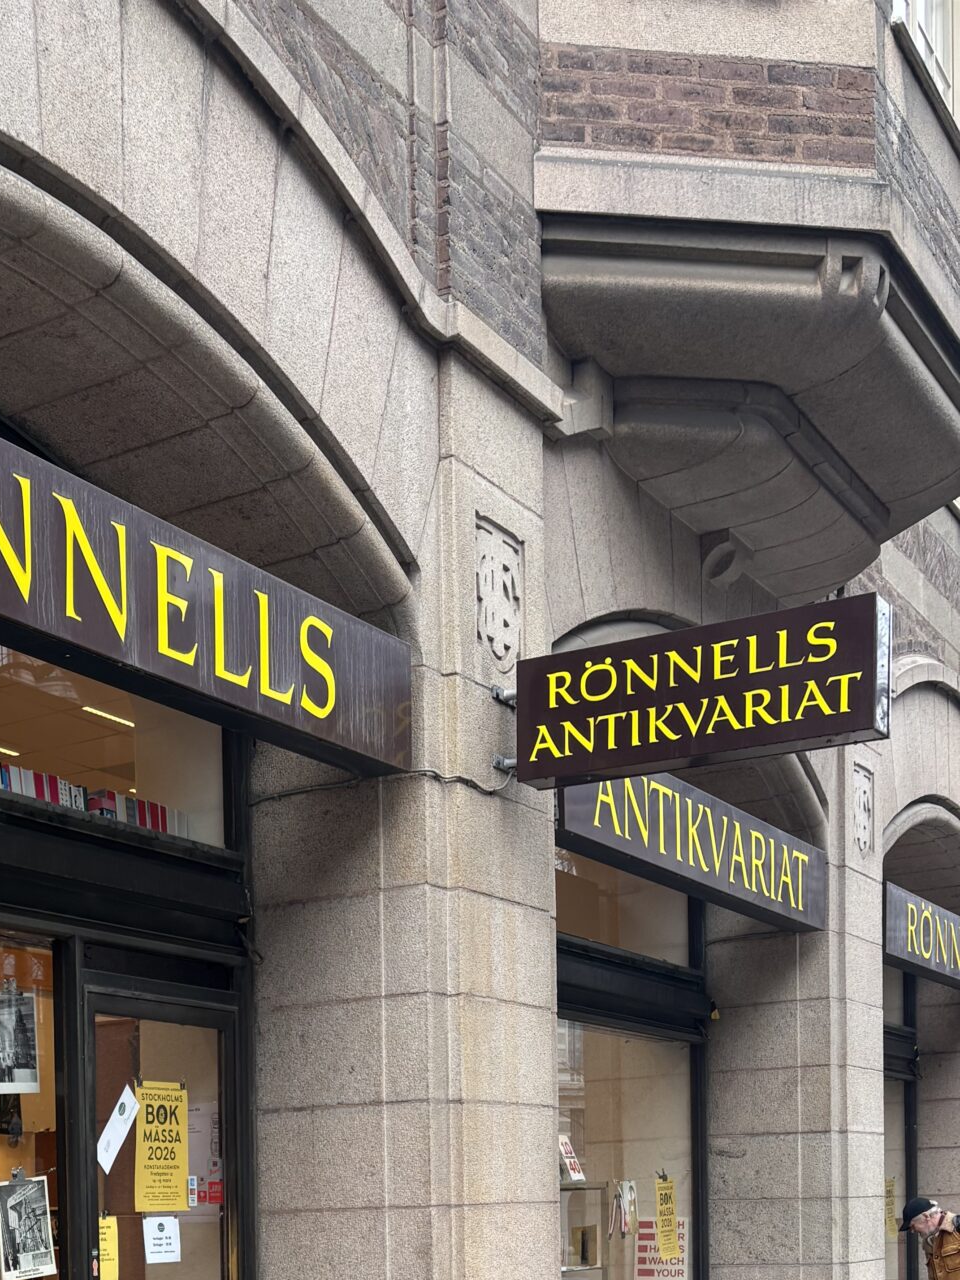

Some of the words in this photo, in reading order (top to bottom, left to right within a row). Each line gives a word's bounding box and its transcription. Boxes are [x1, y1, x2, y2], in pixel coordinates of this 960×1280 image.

[546, 621, 838, 709] RÖNNELLS
[529, 670, 863, 762] ANTIKVARIAT
[593, 774, 809, 911] ANTIKVARIAT
[141, 1092, 183, 1102] STOCKHOLMS
[145, 1104, 180, 1126] BOK
[143, 1125, 182, 1143] MÄSSA
[148, 1146, 176, 1160] 2026
[655, 1268, 684, 1277] YOUR
